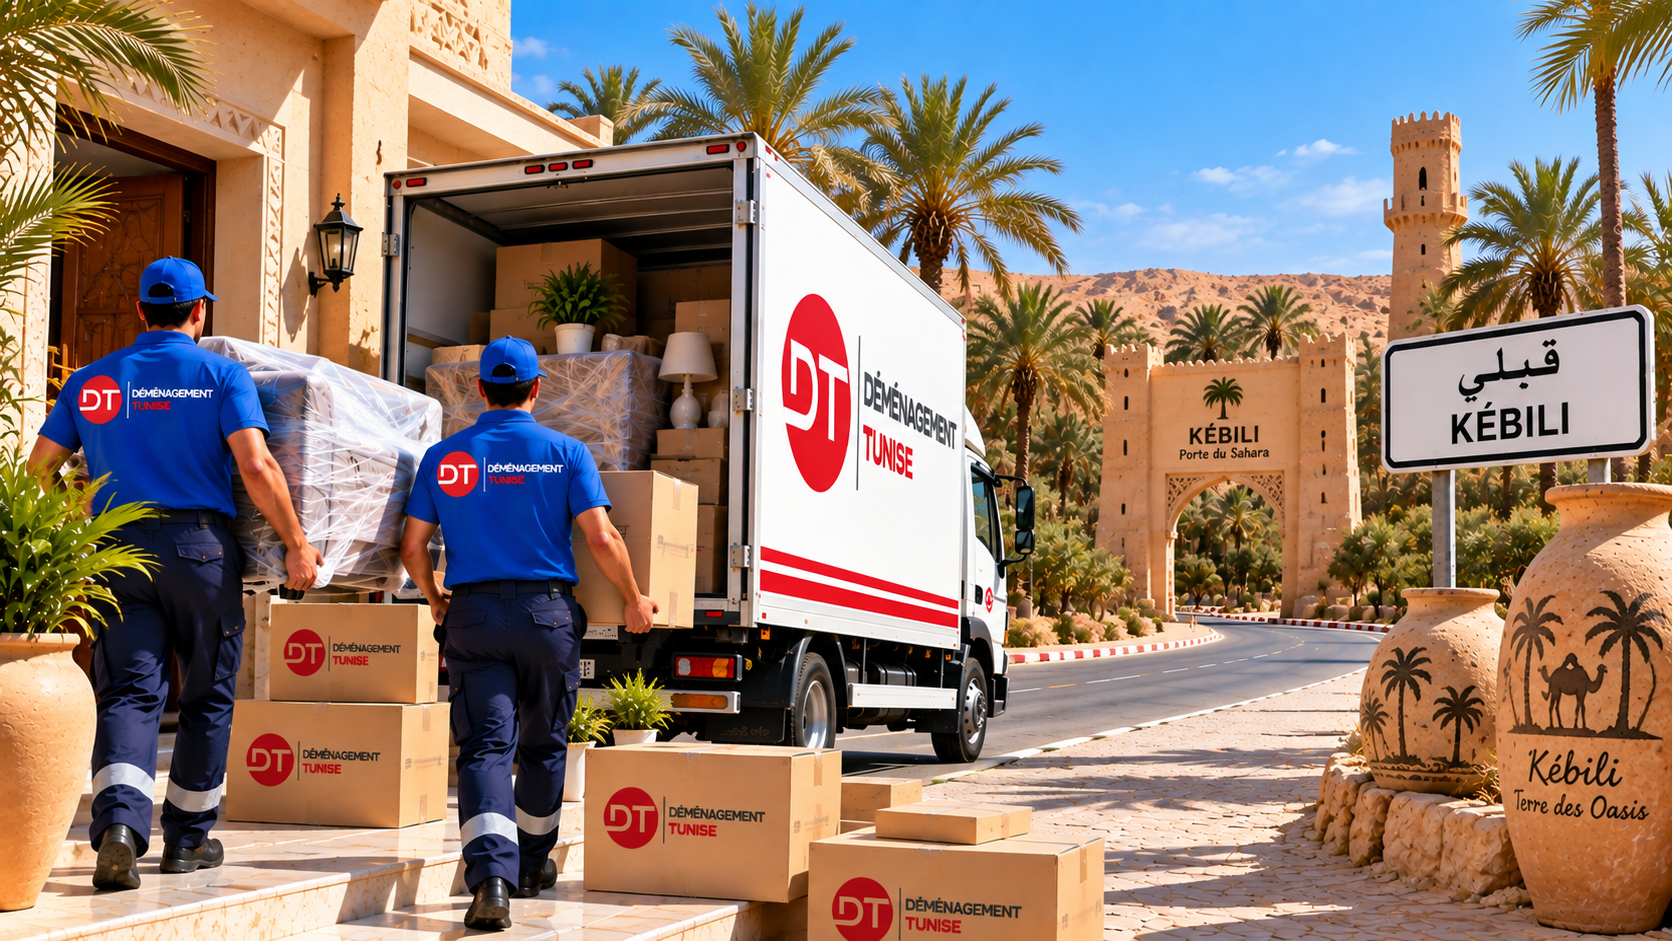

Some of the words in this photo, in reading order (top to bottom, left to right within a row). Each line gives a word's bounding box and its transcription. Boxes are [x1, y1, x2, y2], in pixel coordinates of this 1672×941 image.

[1458, 339, 1560, 403] قبلي
[79, 389, 121, 411] DT
[131, 387, 214, 398] DÉMÉNAGEMENT
[783, 339, 849, 442] DT
[864, 370, 957, 450] DÉMÉNAGEMENT
[1189, 422, 1259, 445] KÉBILI
[1451, 401, 1569, 445] KÉBILI
[863, 424, 913, 480] TUNISE
[1179, 449, 1209, 460] Porte
[1213, 448, 1226, 459] du
[1230, 447, 1270, 459] Sahara
[437, 464, 477, 485] DT
[487, 462, 564, 473] DÉMÉNAGEMENT
[284, 642, 323, 664] DT
[332, 642, 401, 654] DÉMÉNAGEMENT
[332, 655, 369, 666] TUNISE
[247, 748, 291, 773] DT
[302, 748, 381, 762] DÉMÉNAGEMENT
[302, 763, 342, 775] TUNISE
[1528, 748, 1623, 787] Kébili
[668, 805, 766, 823] DÉMÉNAGEMENT
[1513, 789, 1549, 814] Terre
[1553, 793, 1584, 817] des
[1590, 795, 1650, 820] Oasis
[605, 804, 655, 833] DT
[668, 822, 717, 838] TUNISE
[833, 896, 890, 929] DT
[905, 896, 1022, 919] DÉMÉNAGEMENT
[905, 916, 962, 934] TUNISE
